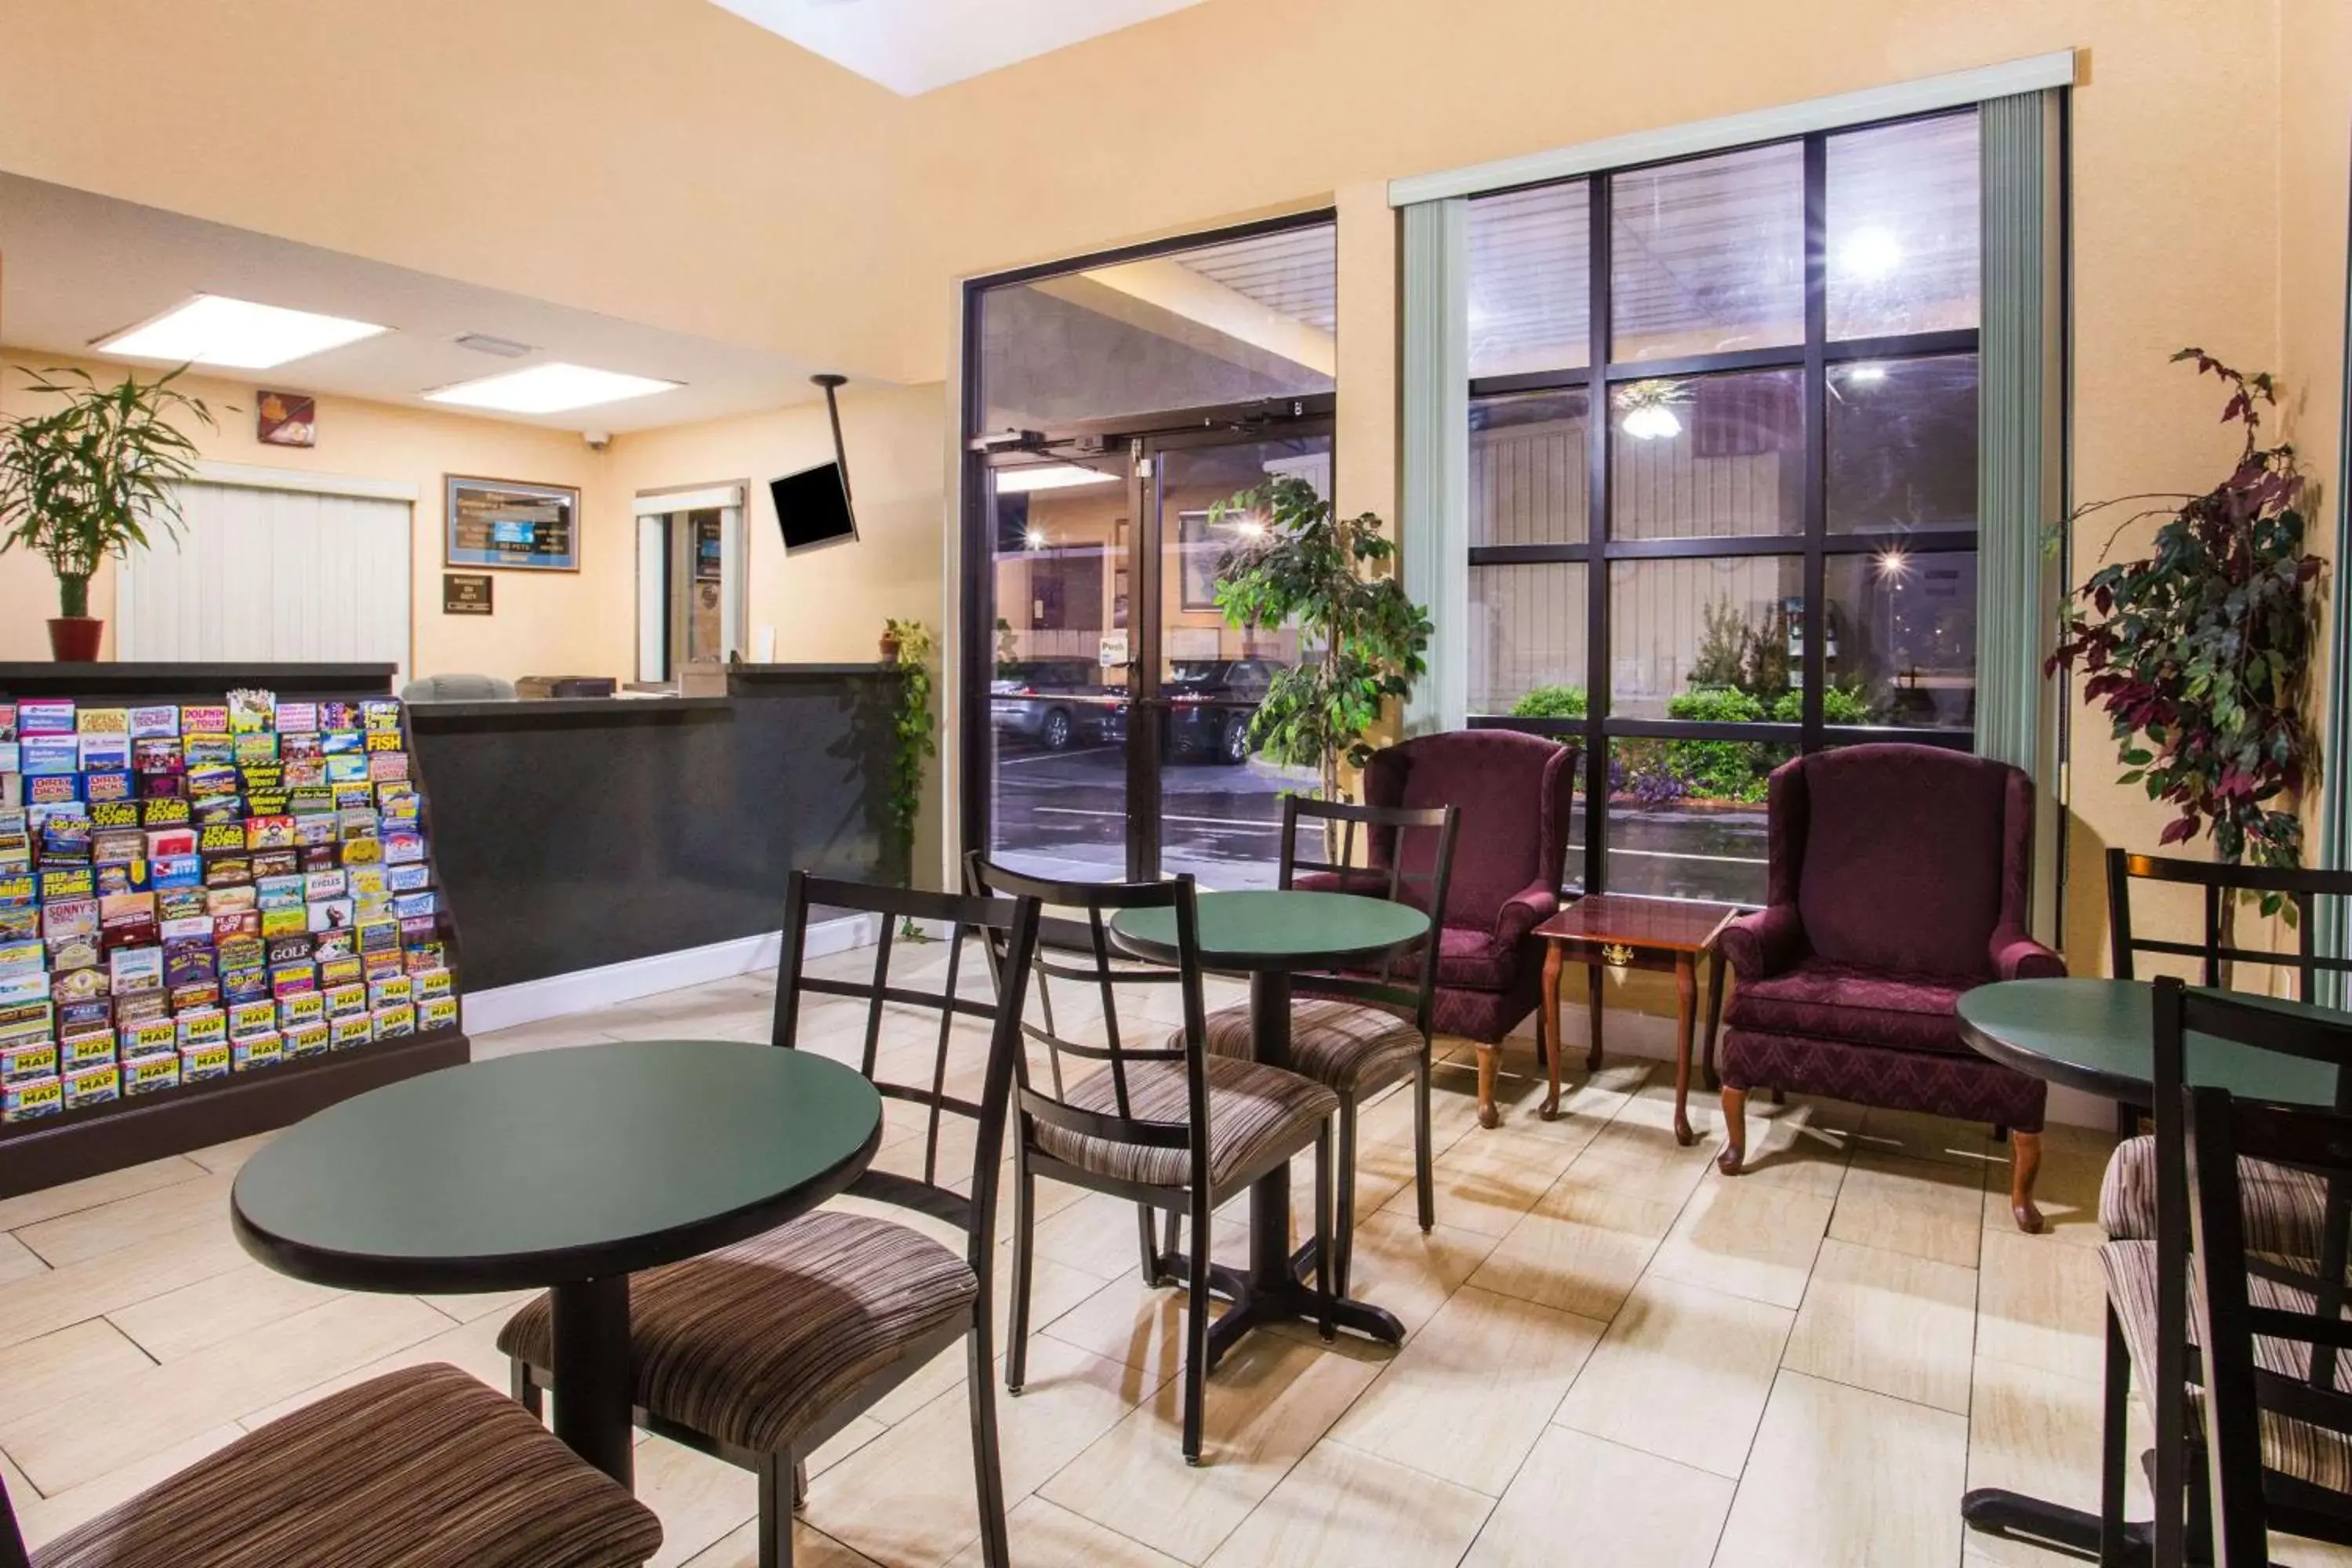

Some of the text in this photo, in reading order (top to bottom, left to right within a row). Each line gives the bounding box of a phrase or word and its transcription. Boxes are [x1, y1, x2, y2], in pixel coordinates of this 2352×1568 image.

[184, 709, 226, 719] DOLPHIN
[367, 735, 401, 750] FISH
[310, 877, 341, 887] CYCLES
[48, 902, 96, 917] SONNY'S
[219, 924, 239, 932] OFF
[270, 943, 311, 960] GOLF
[426, 976, 449, 989] MAP
[385, 984, 409, 995] MAP
[337, 992, 362, 1004] MAP
[294, 1003, 321, 1014] MAP
[431, 1006, 455, 1018] MAP
[242, 1011, 270, 1024] MAP
[383, 1012, 408, 1026] MAP
[191, 1021, 220, 1035] MAP
[343, 1022, 368, 1036] MAP
[141, 1030, 172, 1043] MAP
[299, 1033, 326, 1044] MAP
[77, 1044, 111, 1057] MAP
[252, 1044, 280, 1055] MAP
[18, 1054, 53, 1069] MAP
[197, 1054, 227, 1066] MAP
[141, 1065, 172, 1079] MAP
[78, 1076, 113, 1091] MAP
[24, 1088, 60, 1105] MAP
